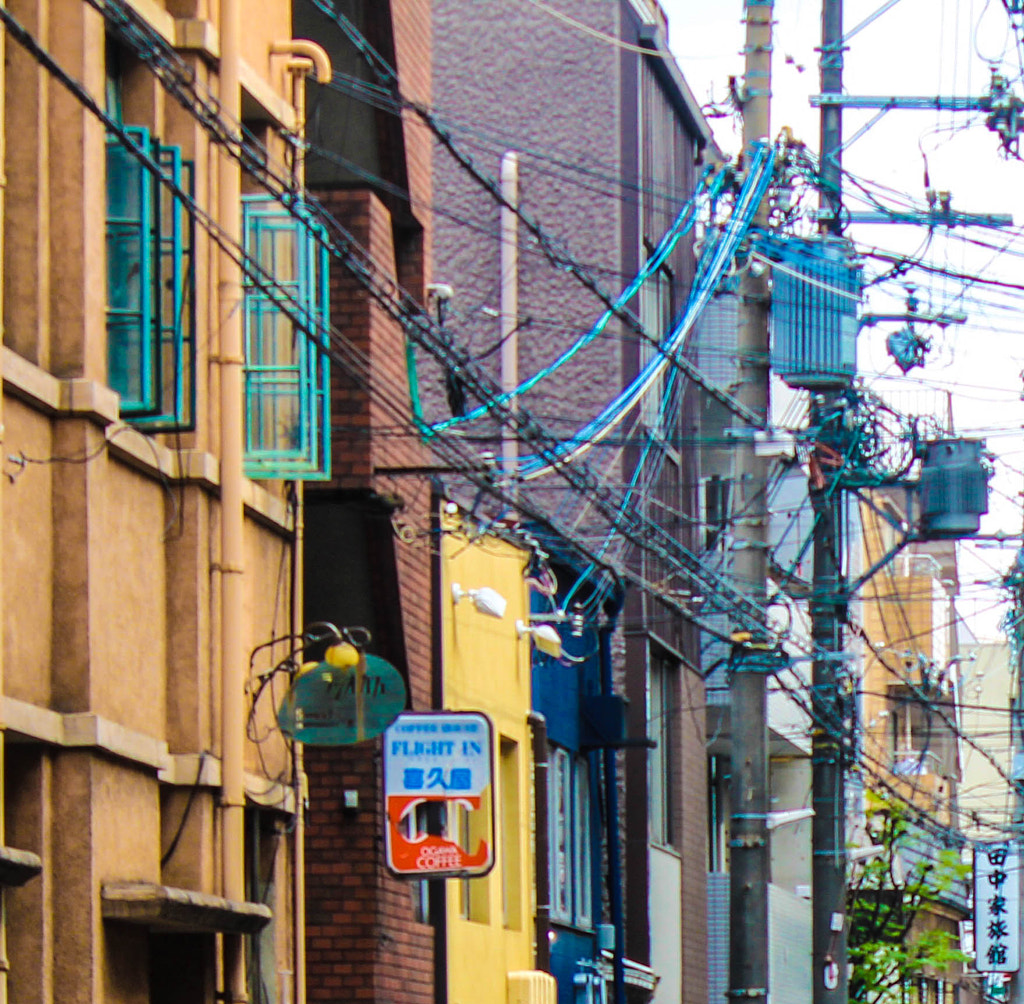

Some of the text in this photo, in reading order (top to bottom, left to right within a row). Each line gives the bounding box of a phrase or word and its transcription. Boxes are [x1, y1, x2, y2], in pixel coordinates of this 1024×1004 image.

[391, 740, 482, 756] FLIGHT IN
[416, 856, 462, 869] COFFEE
[986, 848, 1008, 965] 田中家旅館
